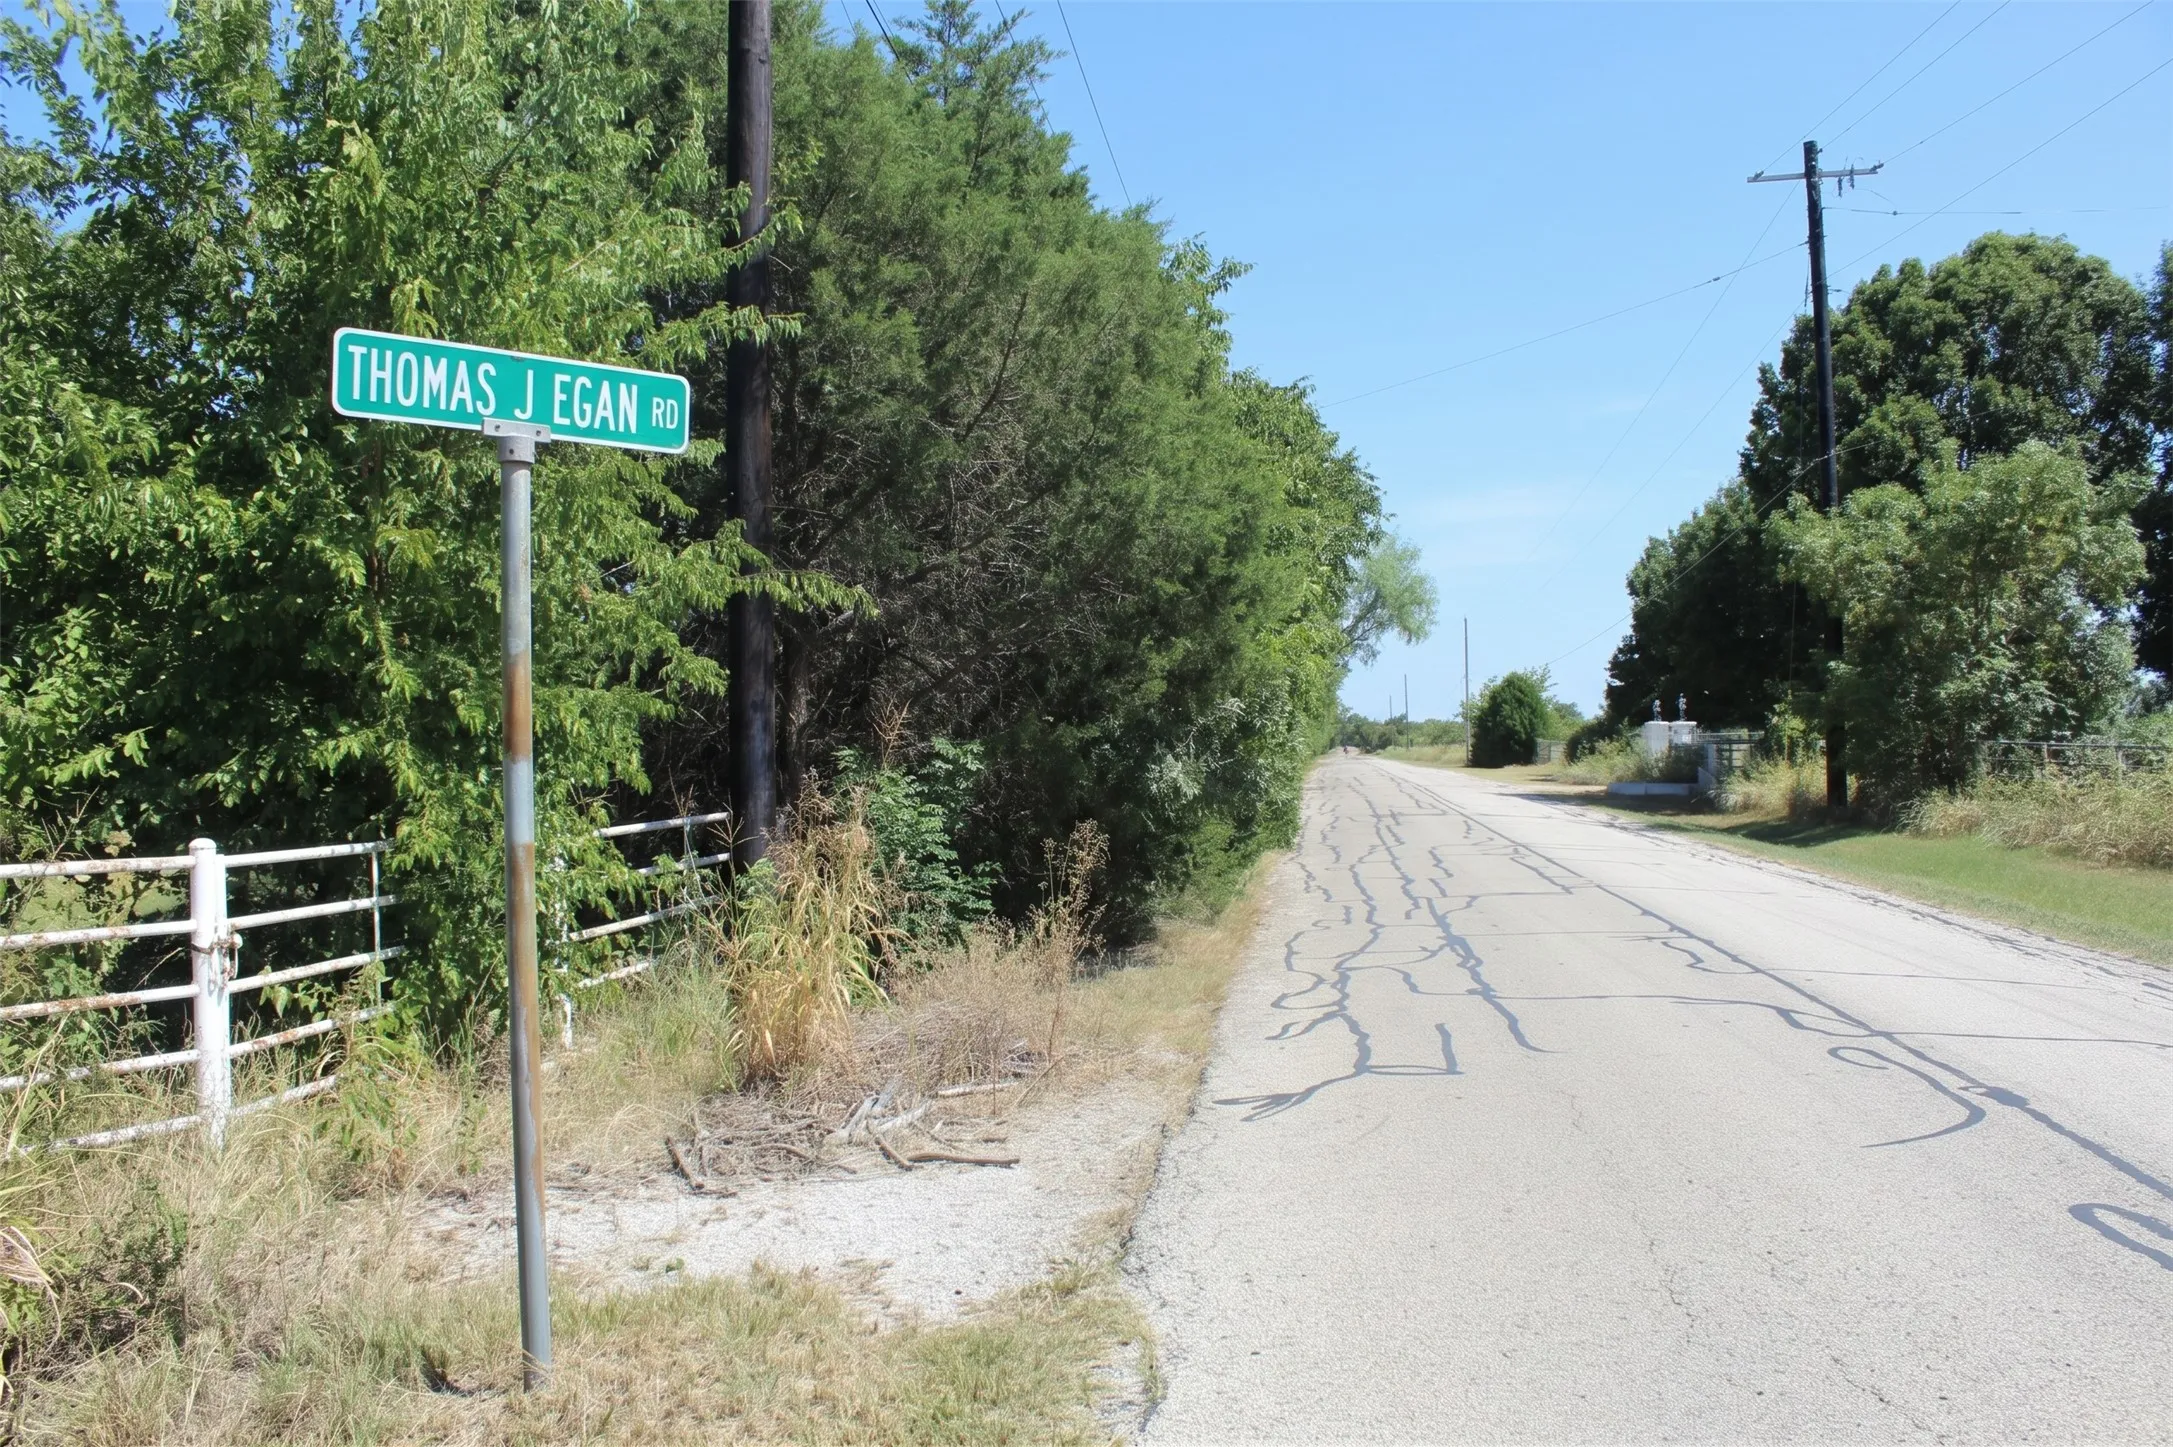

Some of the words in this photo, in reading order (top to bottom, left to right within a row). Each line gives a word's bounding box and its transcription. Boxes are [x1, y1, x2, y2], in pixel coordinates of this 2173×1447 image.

[348, 345, 497, 416] THOMAS
[514, 369, 534, 420] J
[553, 373, 638, 434] EGAN
[651, 397, 679, 430] RD
